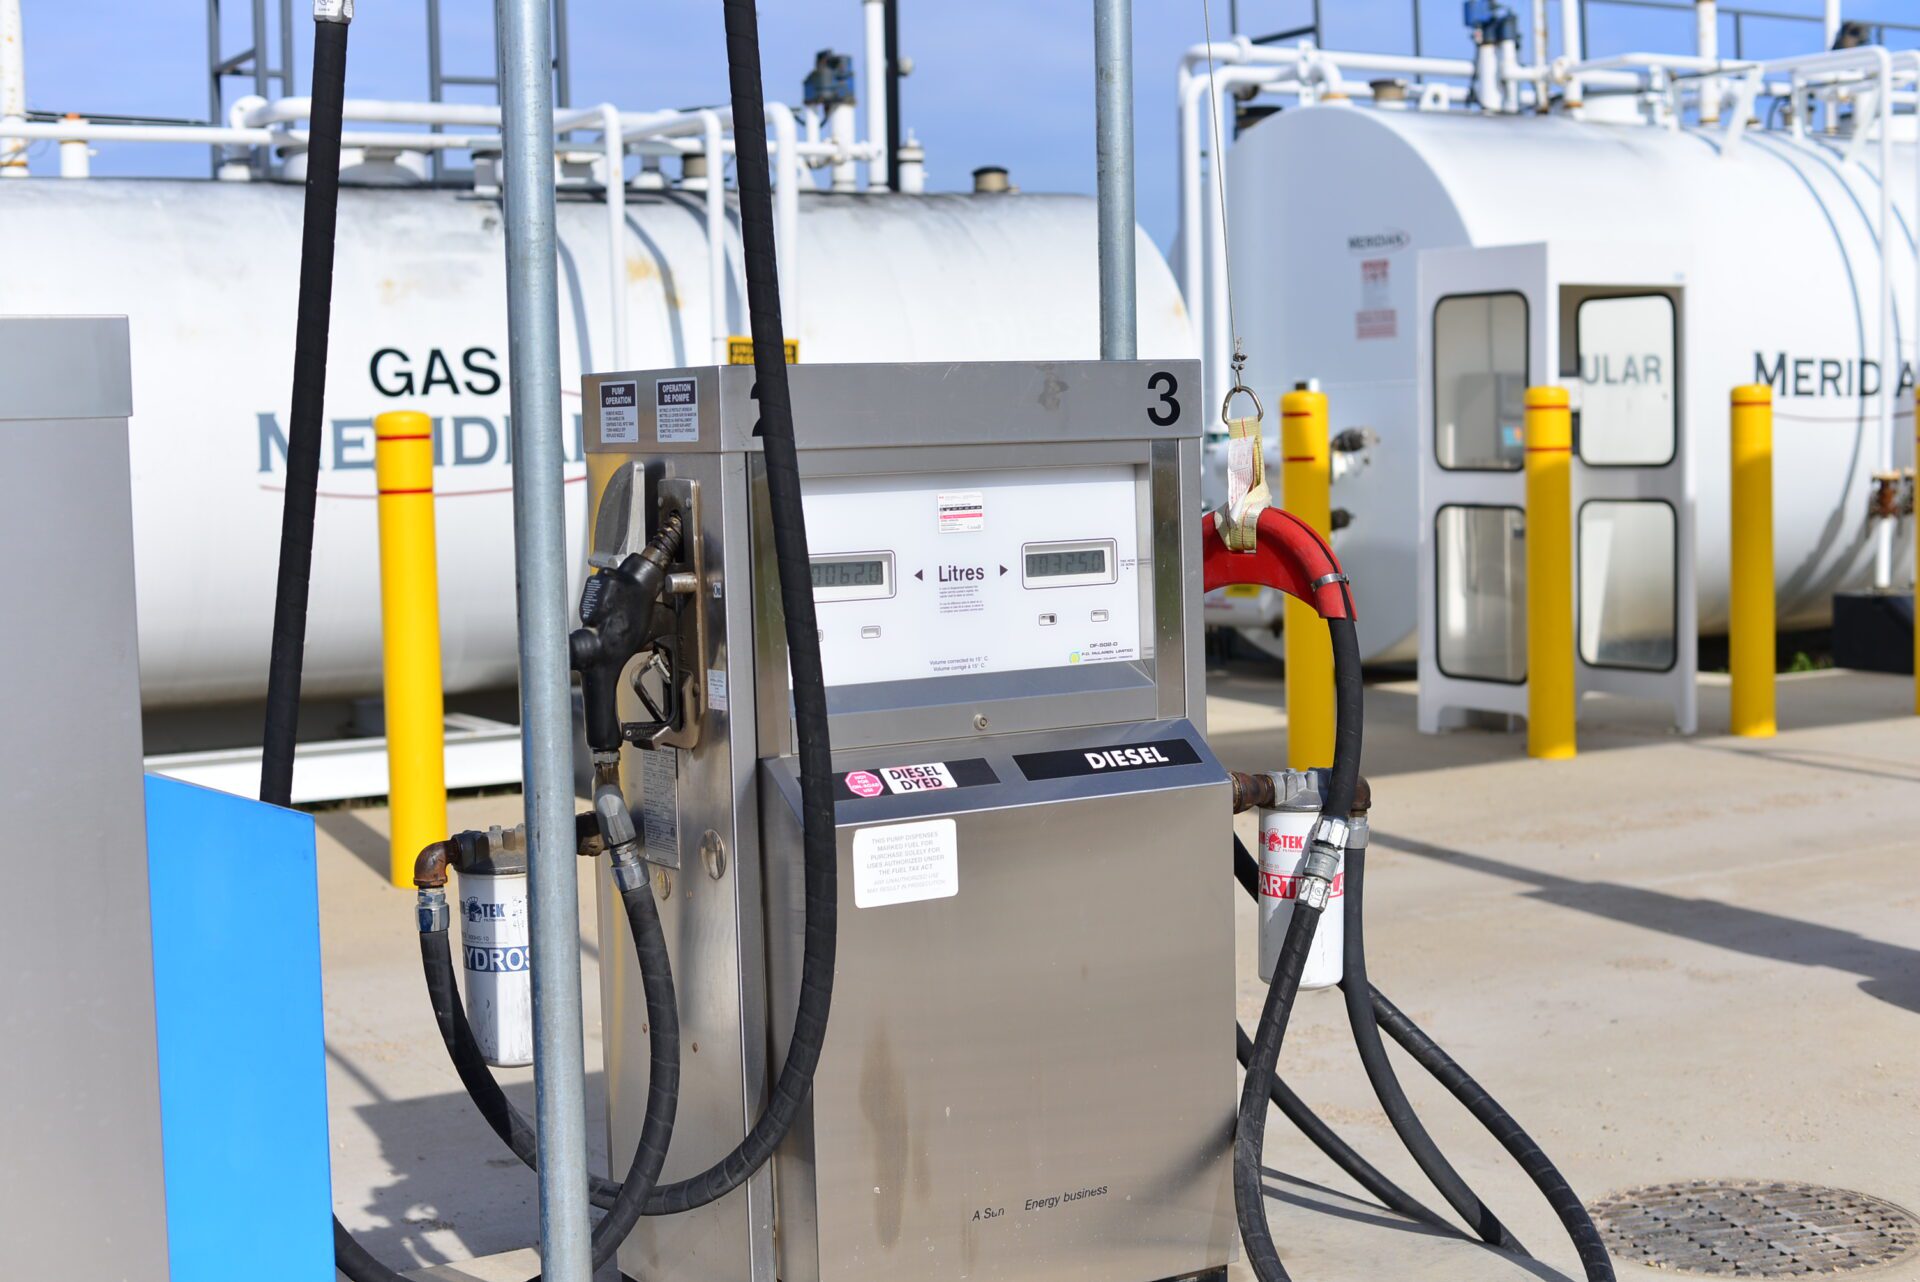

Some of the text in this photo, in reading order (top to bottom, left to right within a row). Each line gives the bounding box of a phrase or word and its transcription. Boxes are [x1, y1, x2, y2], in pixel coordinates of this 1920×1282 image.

[369, 348, 500, 397] GAS
[611, 386, 625, 395] PUMP
[662, 383, 691, 393] OPERATION
[605, 396, 632, 405] OPERATION
[664, 393, 690, 403] DE POMPE
[1147, 371, 1181, 427] 3
[939, 565, 985, 582] Litres
[1084, 746, 1169, 769] DIESEL
[889, 766, 942, 780] DIESEL
[900, 778, 943, 790] DYED
[872, 832, 938, 846] THIS PUMP DISPENSES
[877, 843, 903, 851] MARKED
[904, 841, 919, 849] FUEL
[1281, 835, 1303, 848] TEK
[870, 846, 941, 861] PURCHASE SOLELY FOR
[866, 854, 945, 870] USES AUTHORIZED UNDER
[481, 903, 505, 917] TEK
[972, 1210, 980, 1221] A
[1025, 1196, 1060, 1211] Energy
[1063, 1185, 1108, 1203] business
